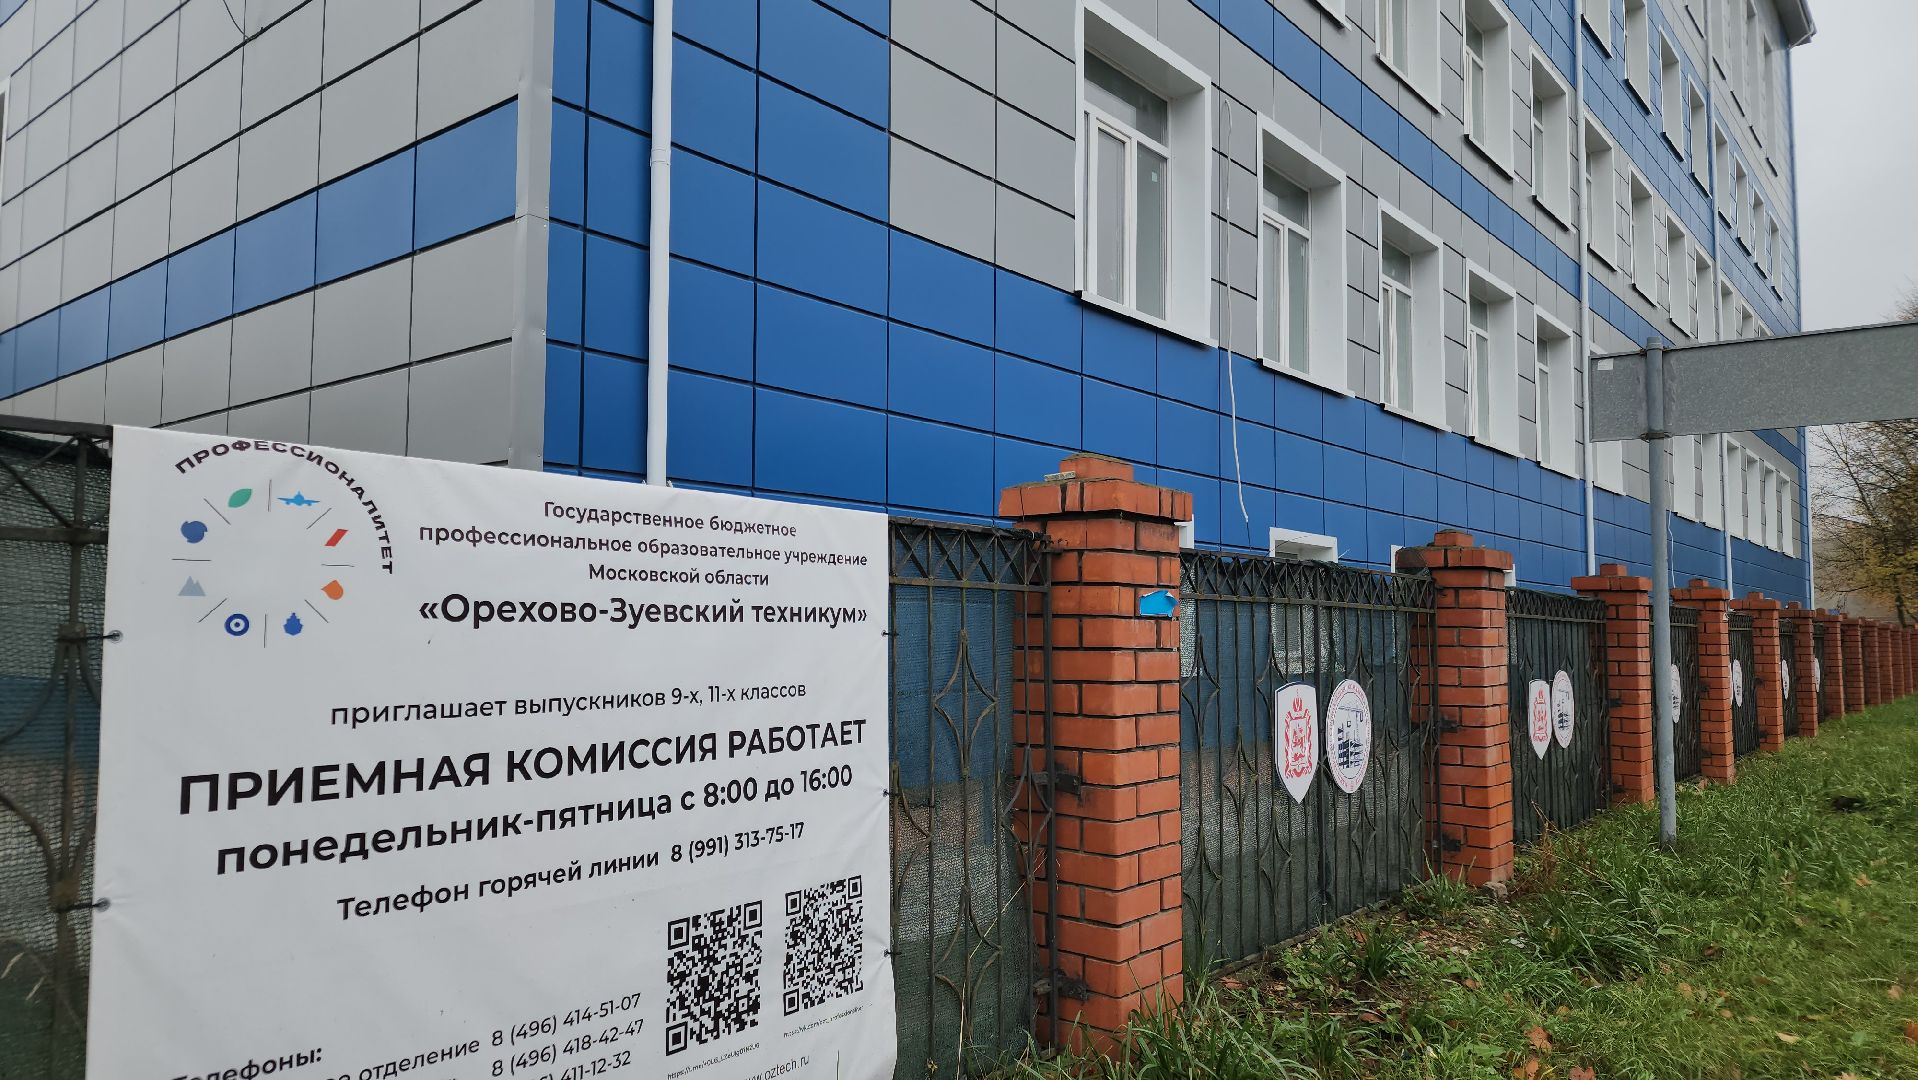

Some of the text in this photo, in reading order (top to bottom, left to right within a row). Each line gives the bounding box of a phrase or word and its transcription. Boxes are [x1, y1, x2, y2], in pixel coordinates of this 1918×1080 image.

[175, 440, 393, 575] ПРОФЕССИОНАЛИТЕТ
[544, 502, 797, 537] Государственное бюджетное
[419, 525, 868, 566] профессиональное образовательное учреждение
[589, 564, 769, 586] Московской области
[419, 594, 868, 629] «Орехово-Зуевский техникум»
[331, 684, 806, 729] приглашает выпускников 9-х, 11-х классов
[180, 719, 866, 815] ПРИЕМНАЯ КОМИССИЯ РАБОТАЕТ
[217, 764, 852, 875] понедельник-пятница с 8:00 до 16:00
[336, 822, 804, 920] Телефон горячей линии 8 (991) 313-75-17
[359, 993, 641, 1080] отделение 8 (496) 414-51-07
[491, 1019, 644, 1077] 8 (496) 418-42-47
[172, 1048, 322, 1080] лефоны:
[560, 1050, 631, 1080] 411-12-32
